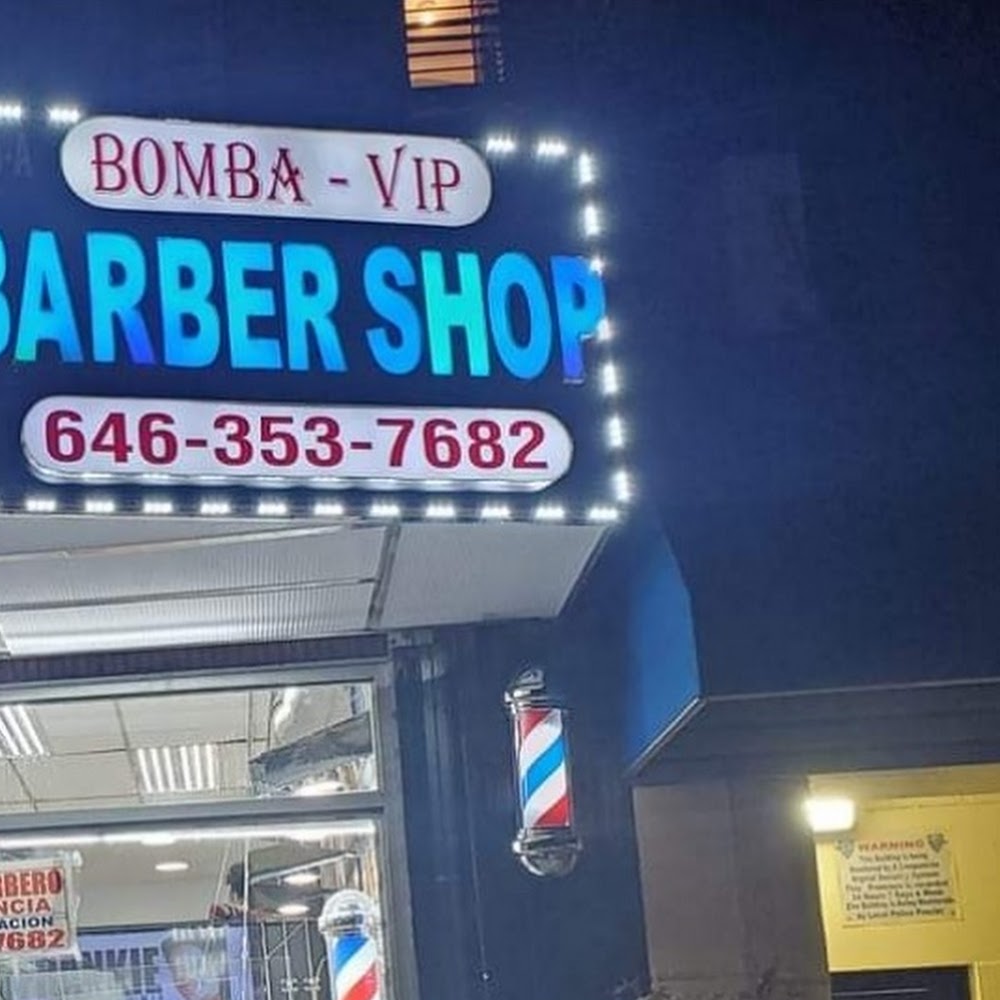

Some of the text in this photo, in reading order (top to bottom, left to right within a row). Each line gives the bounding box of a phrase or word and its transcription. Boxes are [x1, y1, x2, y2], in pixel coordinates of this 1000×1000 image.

[92, 132, 311, 205] BOMBA
[366, 144, 462, 212] VIP
[363, 245, 606, 385] SHOP
[44, 408, 550, 470] 646-353-7682
[858, 839, 925, 852] WARNING
